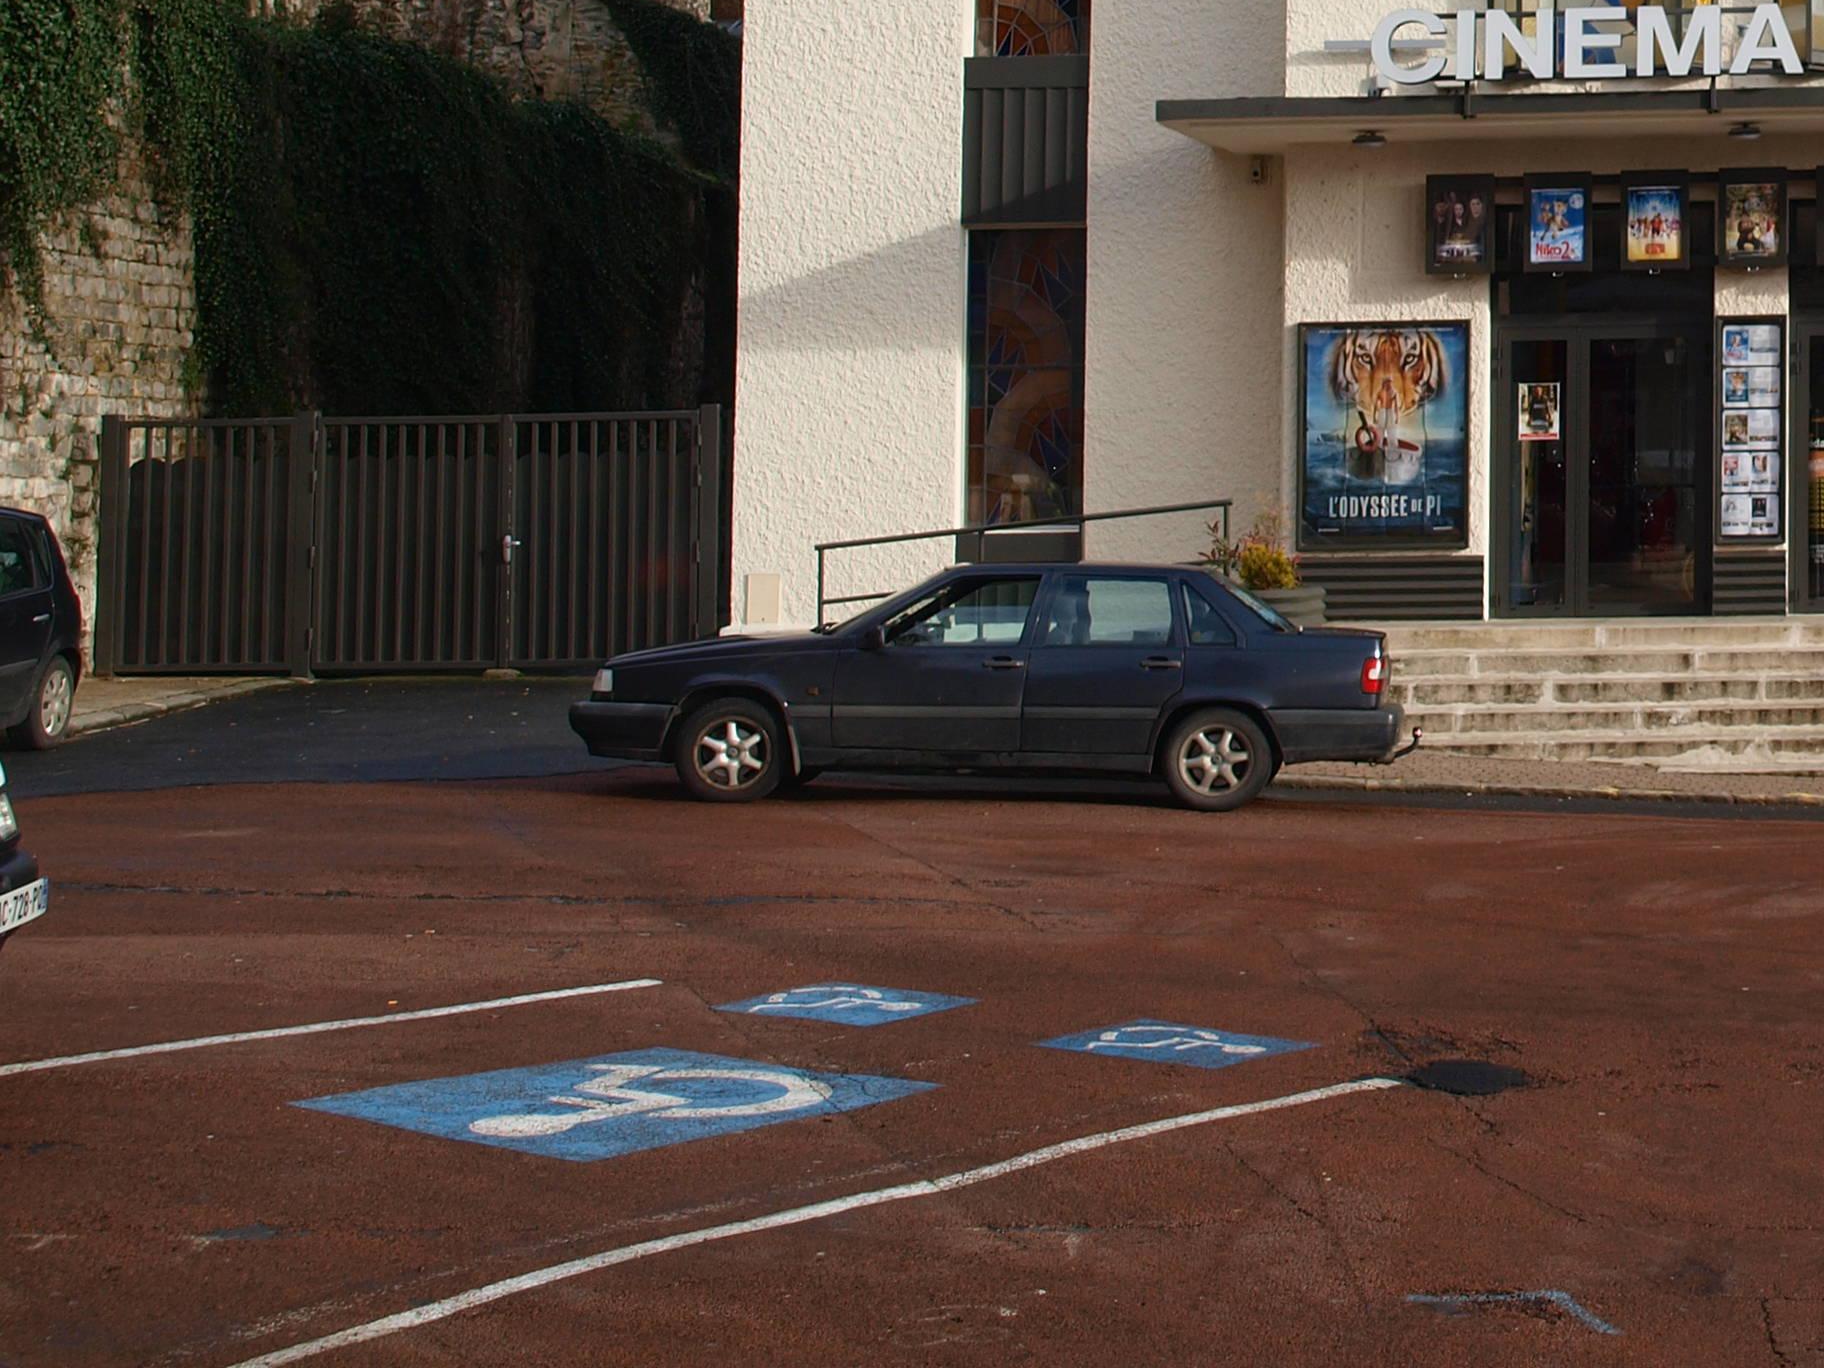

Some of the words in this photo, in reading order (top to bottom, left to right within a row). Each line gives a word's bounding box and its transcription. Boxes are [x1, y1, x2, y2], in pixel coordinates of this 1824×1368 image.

[1370, 3, 1804, 84] CINEMA
[1561, 240, 1570, 260] 2
[1426, 494, 1441, 516] PI
